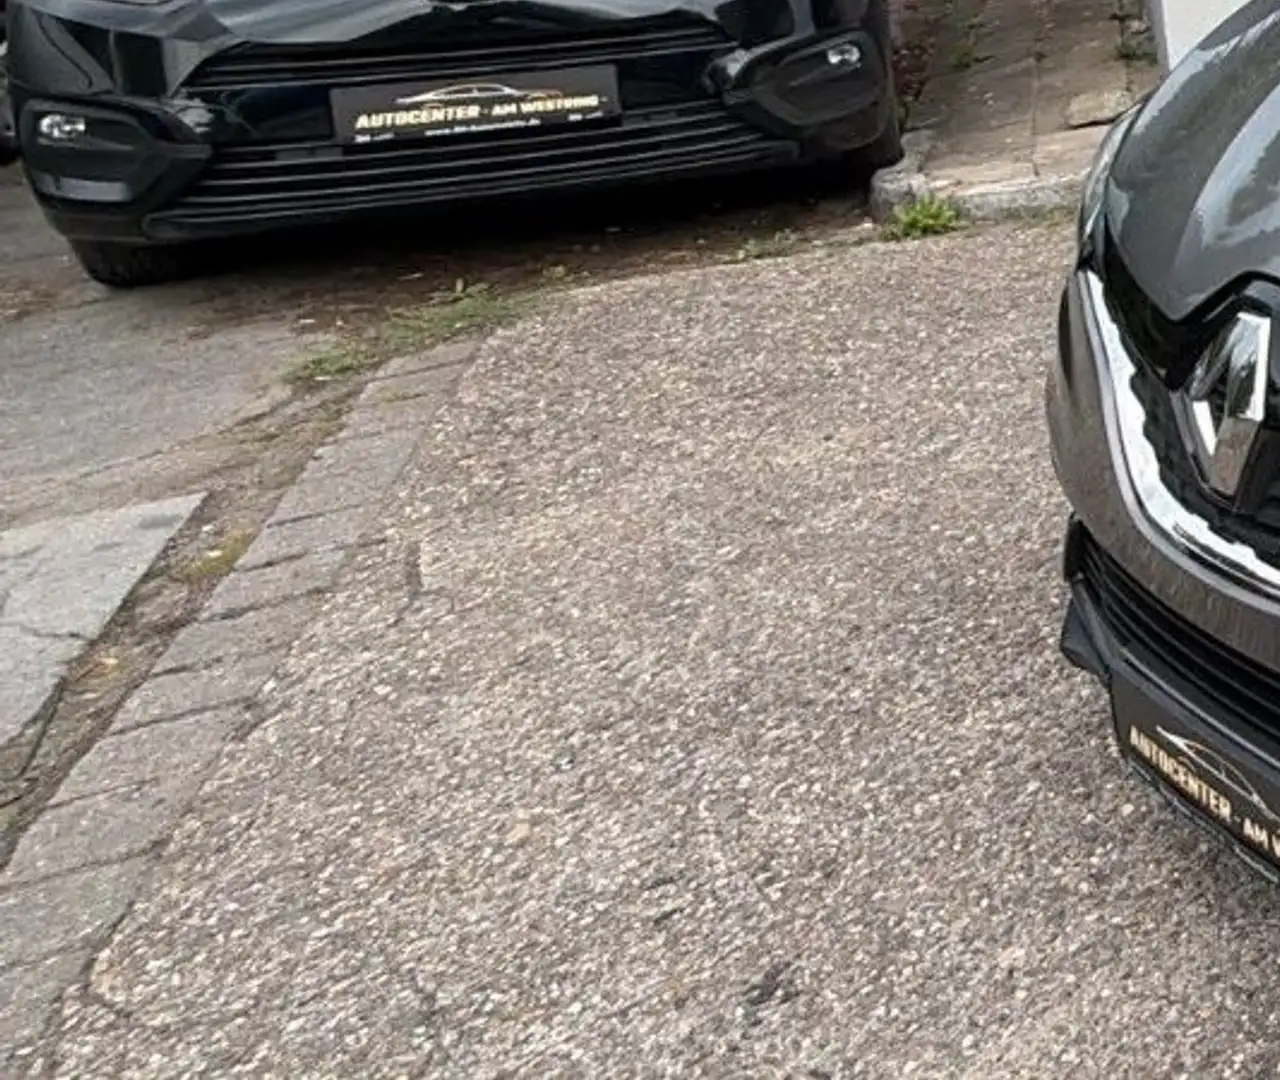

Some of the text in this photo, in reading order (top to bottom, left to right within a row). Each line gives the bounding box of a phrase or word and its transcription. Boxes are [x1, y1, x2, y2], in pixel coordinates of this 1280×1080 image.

[354, 104, 480, 129] AUTOCENTER
[491, 102, 518, 117] AM
[1129, 724, 1232, 822] AUTOCENTER
